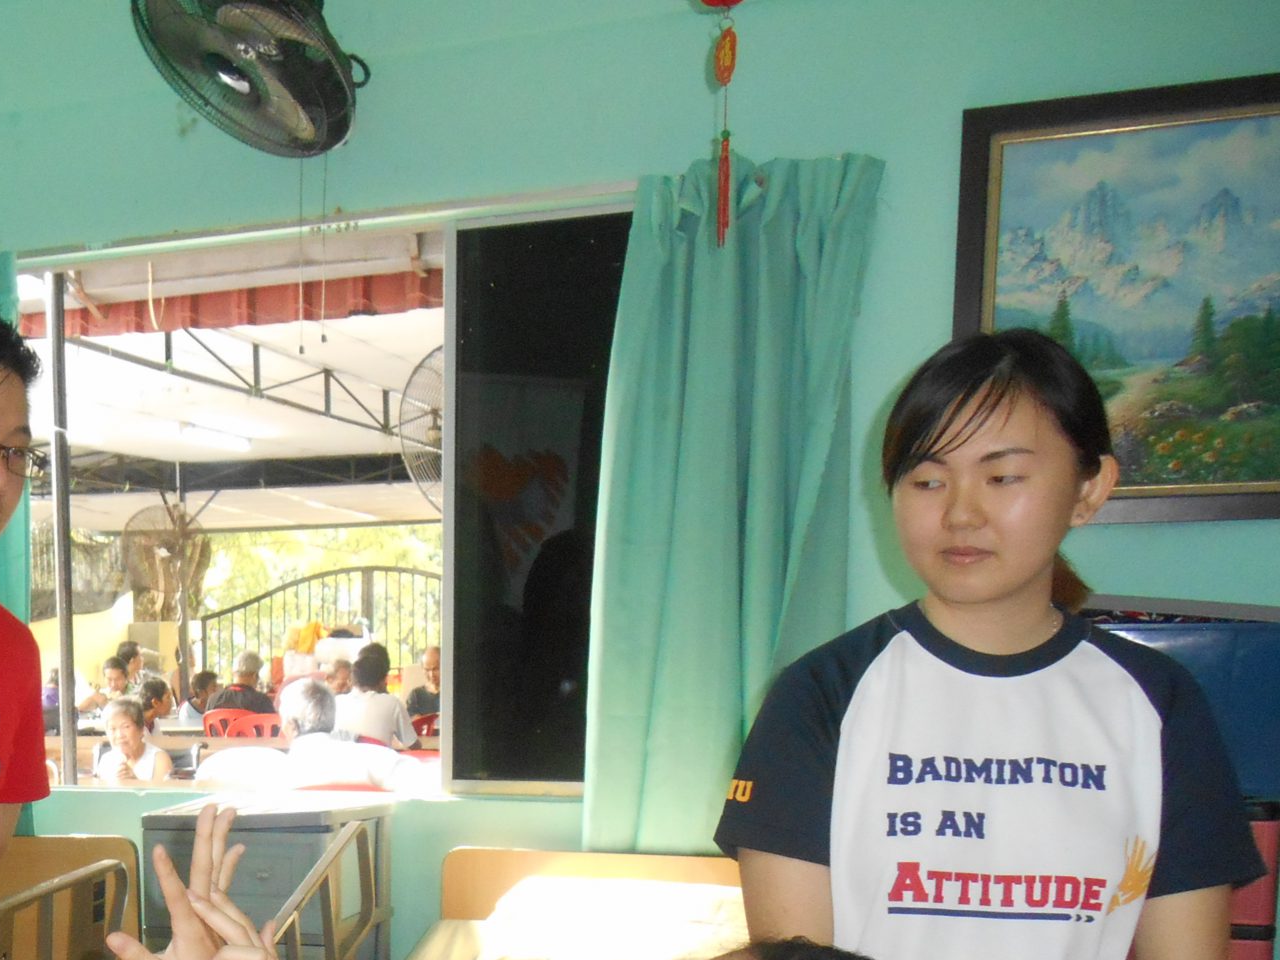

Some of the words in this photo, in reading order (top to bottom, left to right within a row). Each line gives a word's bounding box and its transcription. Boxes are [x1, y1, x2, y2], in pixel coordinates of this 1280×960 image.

[886, 752, 1107, 791] BADMINTON
[886, 810, 922, 838] IS
[935, 810, 987, 839] AN
[887, 861, 1108, 912] ATTITUDE
